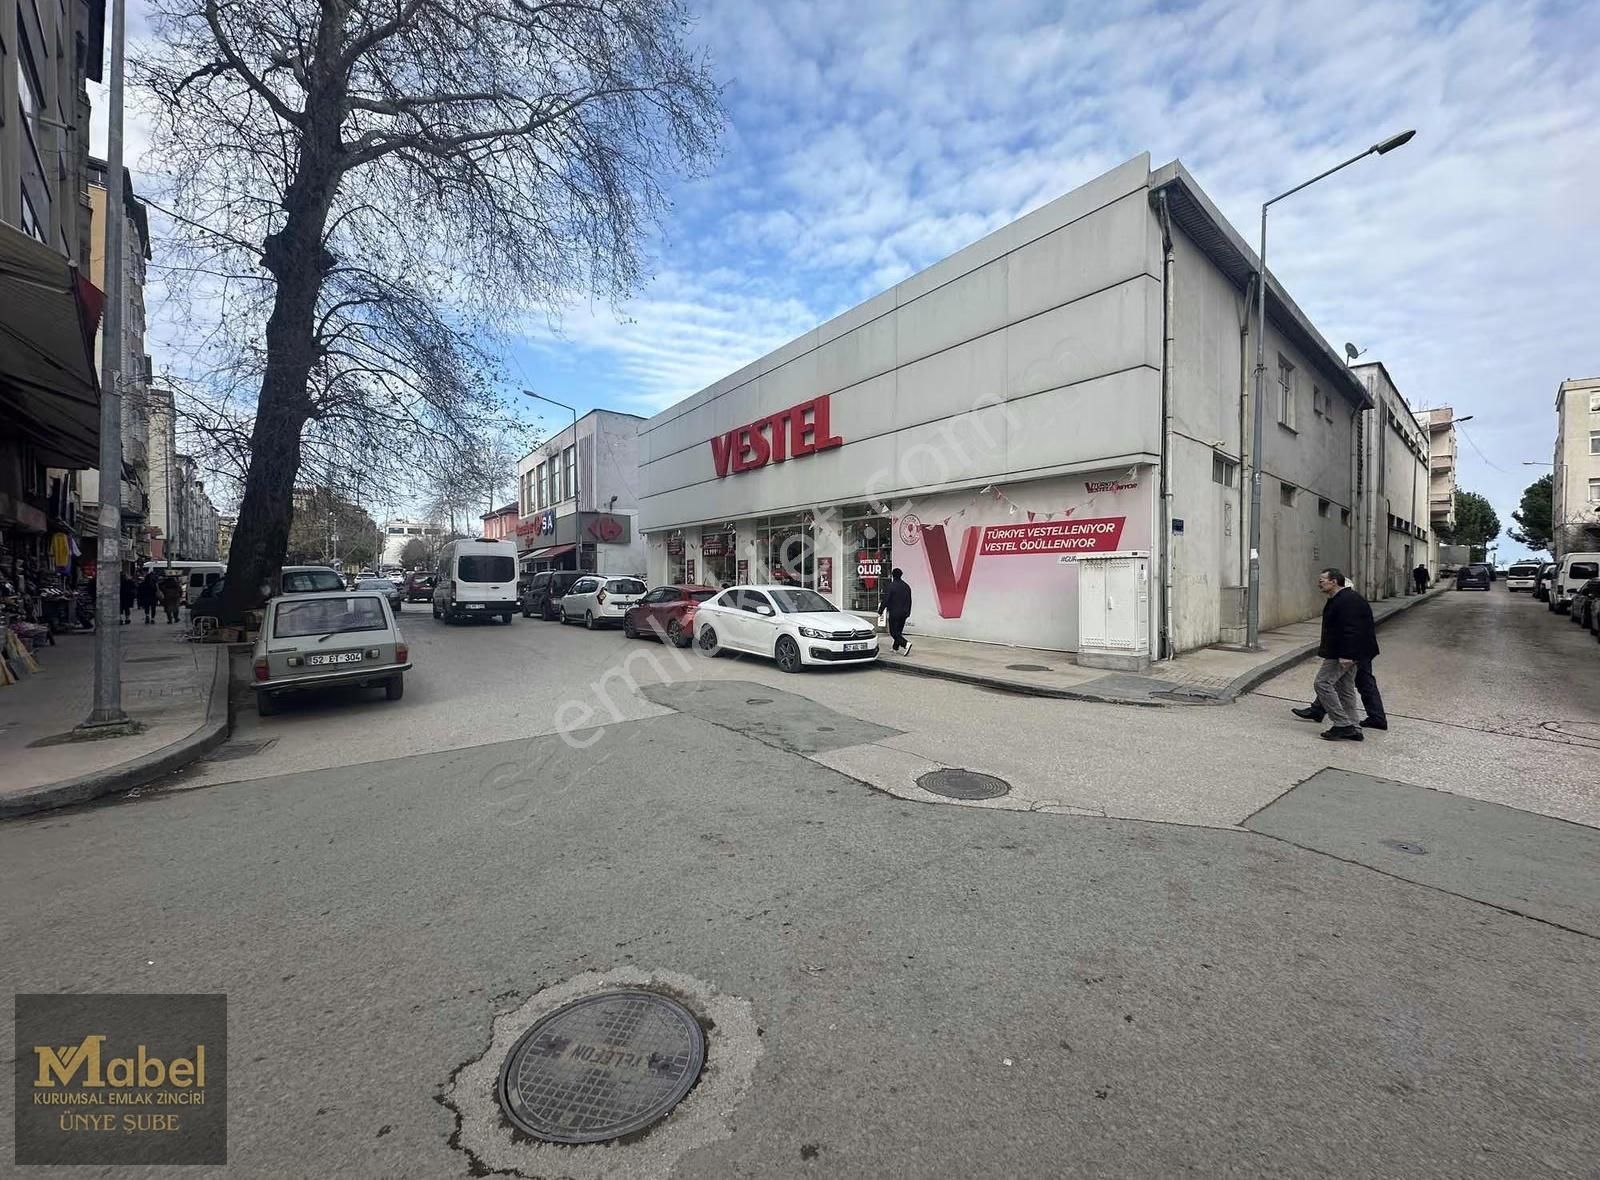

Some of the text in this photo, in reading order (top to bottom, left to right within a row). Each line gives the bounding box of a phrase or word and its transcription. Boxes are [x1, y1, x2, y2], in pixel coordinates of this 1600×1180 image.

[711, 394, 843, 478] VESTEL
[986, 522, 1115, 540] TÜRKİYE VESTELLENİYOR
[984, 538, 1096, 552] VESTEL ÖDÜLLENİYOR
[857, 565, 882, 575] OLUR
[312, 656, 324, 664] 52
[346, 653, 361, 662] 304
